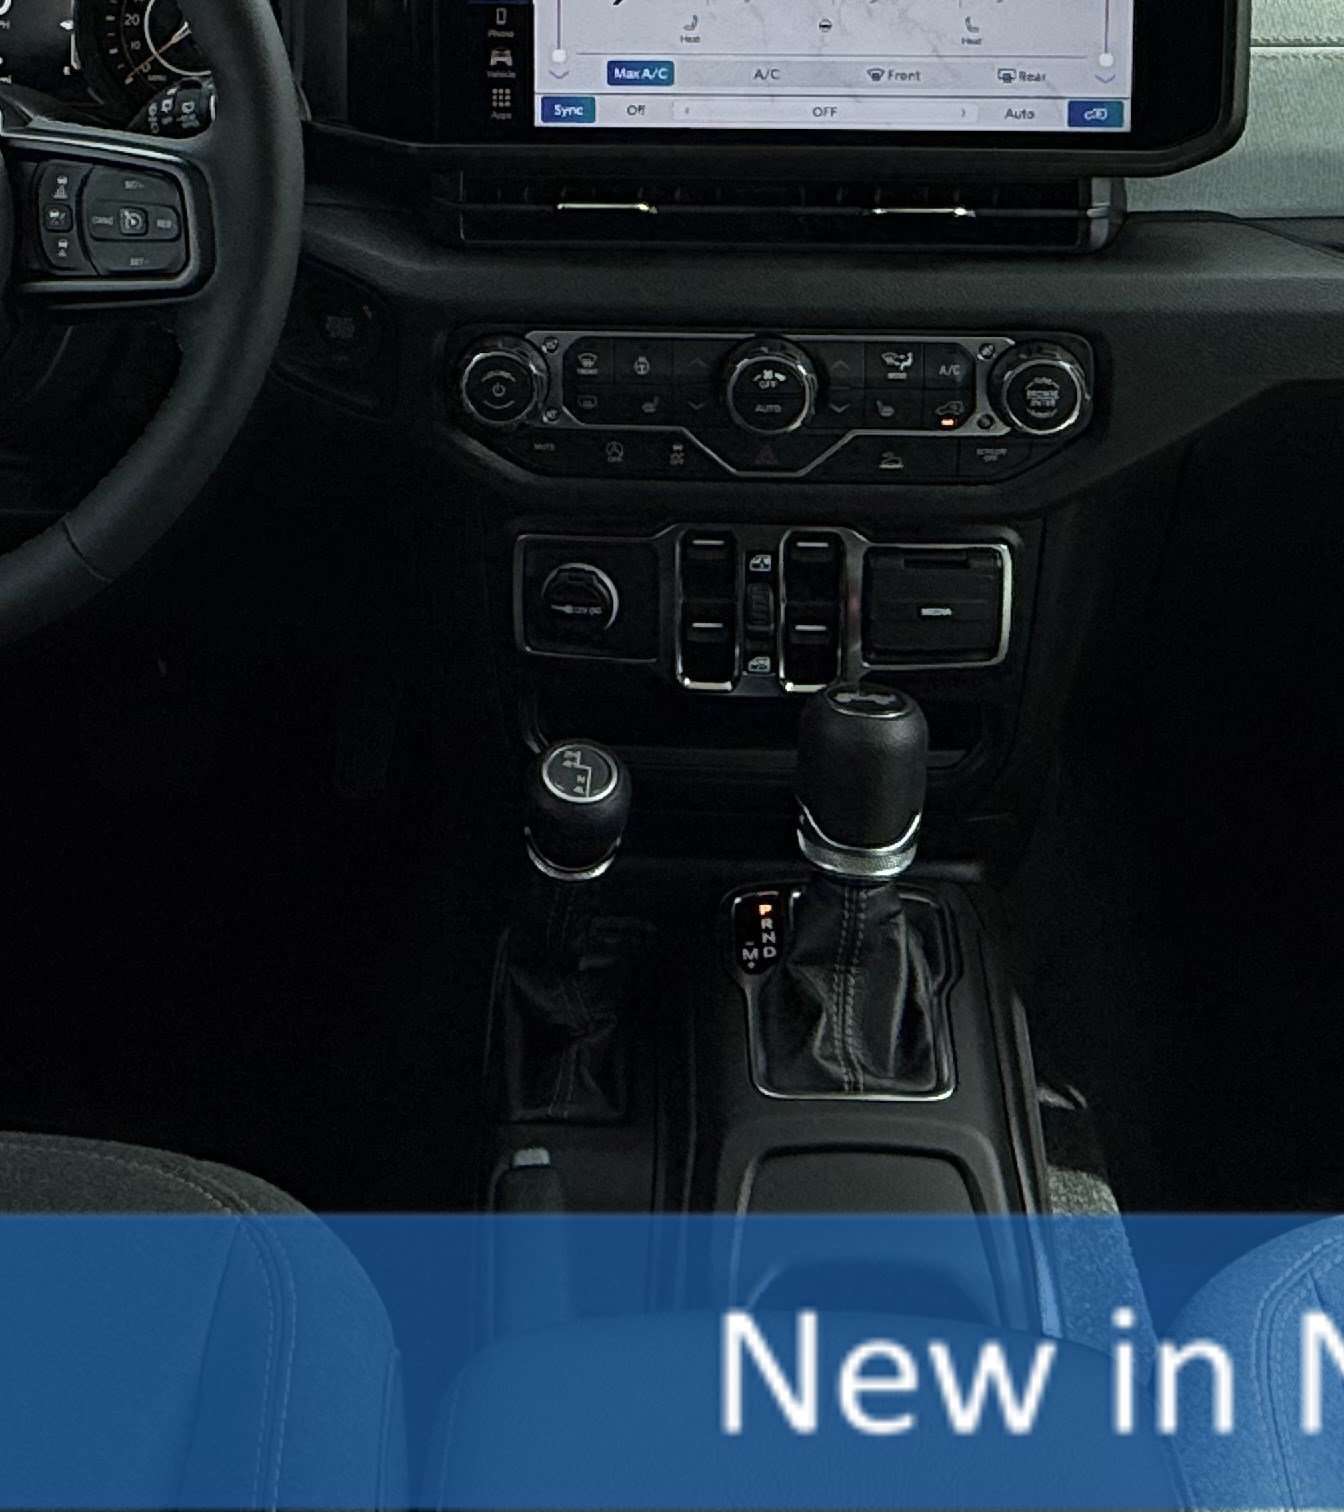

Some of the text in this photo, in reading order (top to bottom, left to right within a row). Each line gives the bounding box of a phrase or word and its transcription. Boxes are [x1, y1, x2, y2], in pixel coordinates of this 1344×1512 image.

[125, 13, 140, 26] 20
[614, 68, 668, 81] Max A/C
[754, 69, 780, 80] A/C
[887, 70, 921, 82] Front
[1018, 71, 1046, 81] Rear
[554, 104, 584, 117] Sync
[812, 107, 837, 118] OFF
[1005, 108, 1035, 119] Auto
[758, 904, 777, 958] P R N D
[742, 948, 759, 960] M
